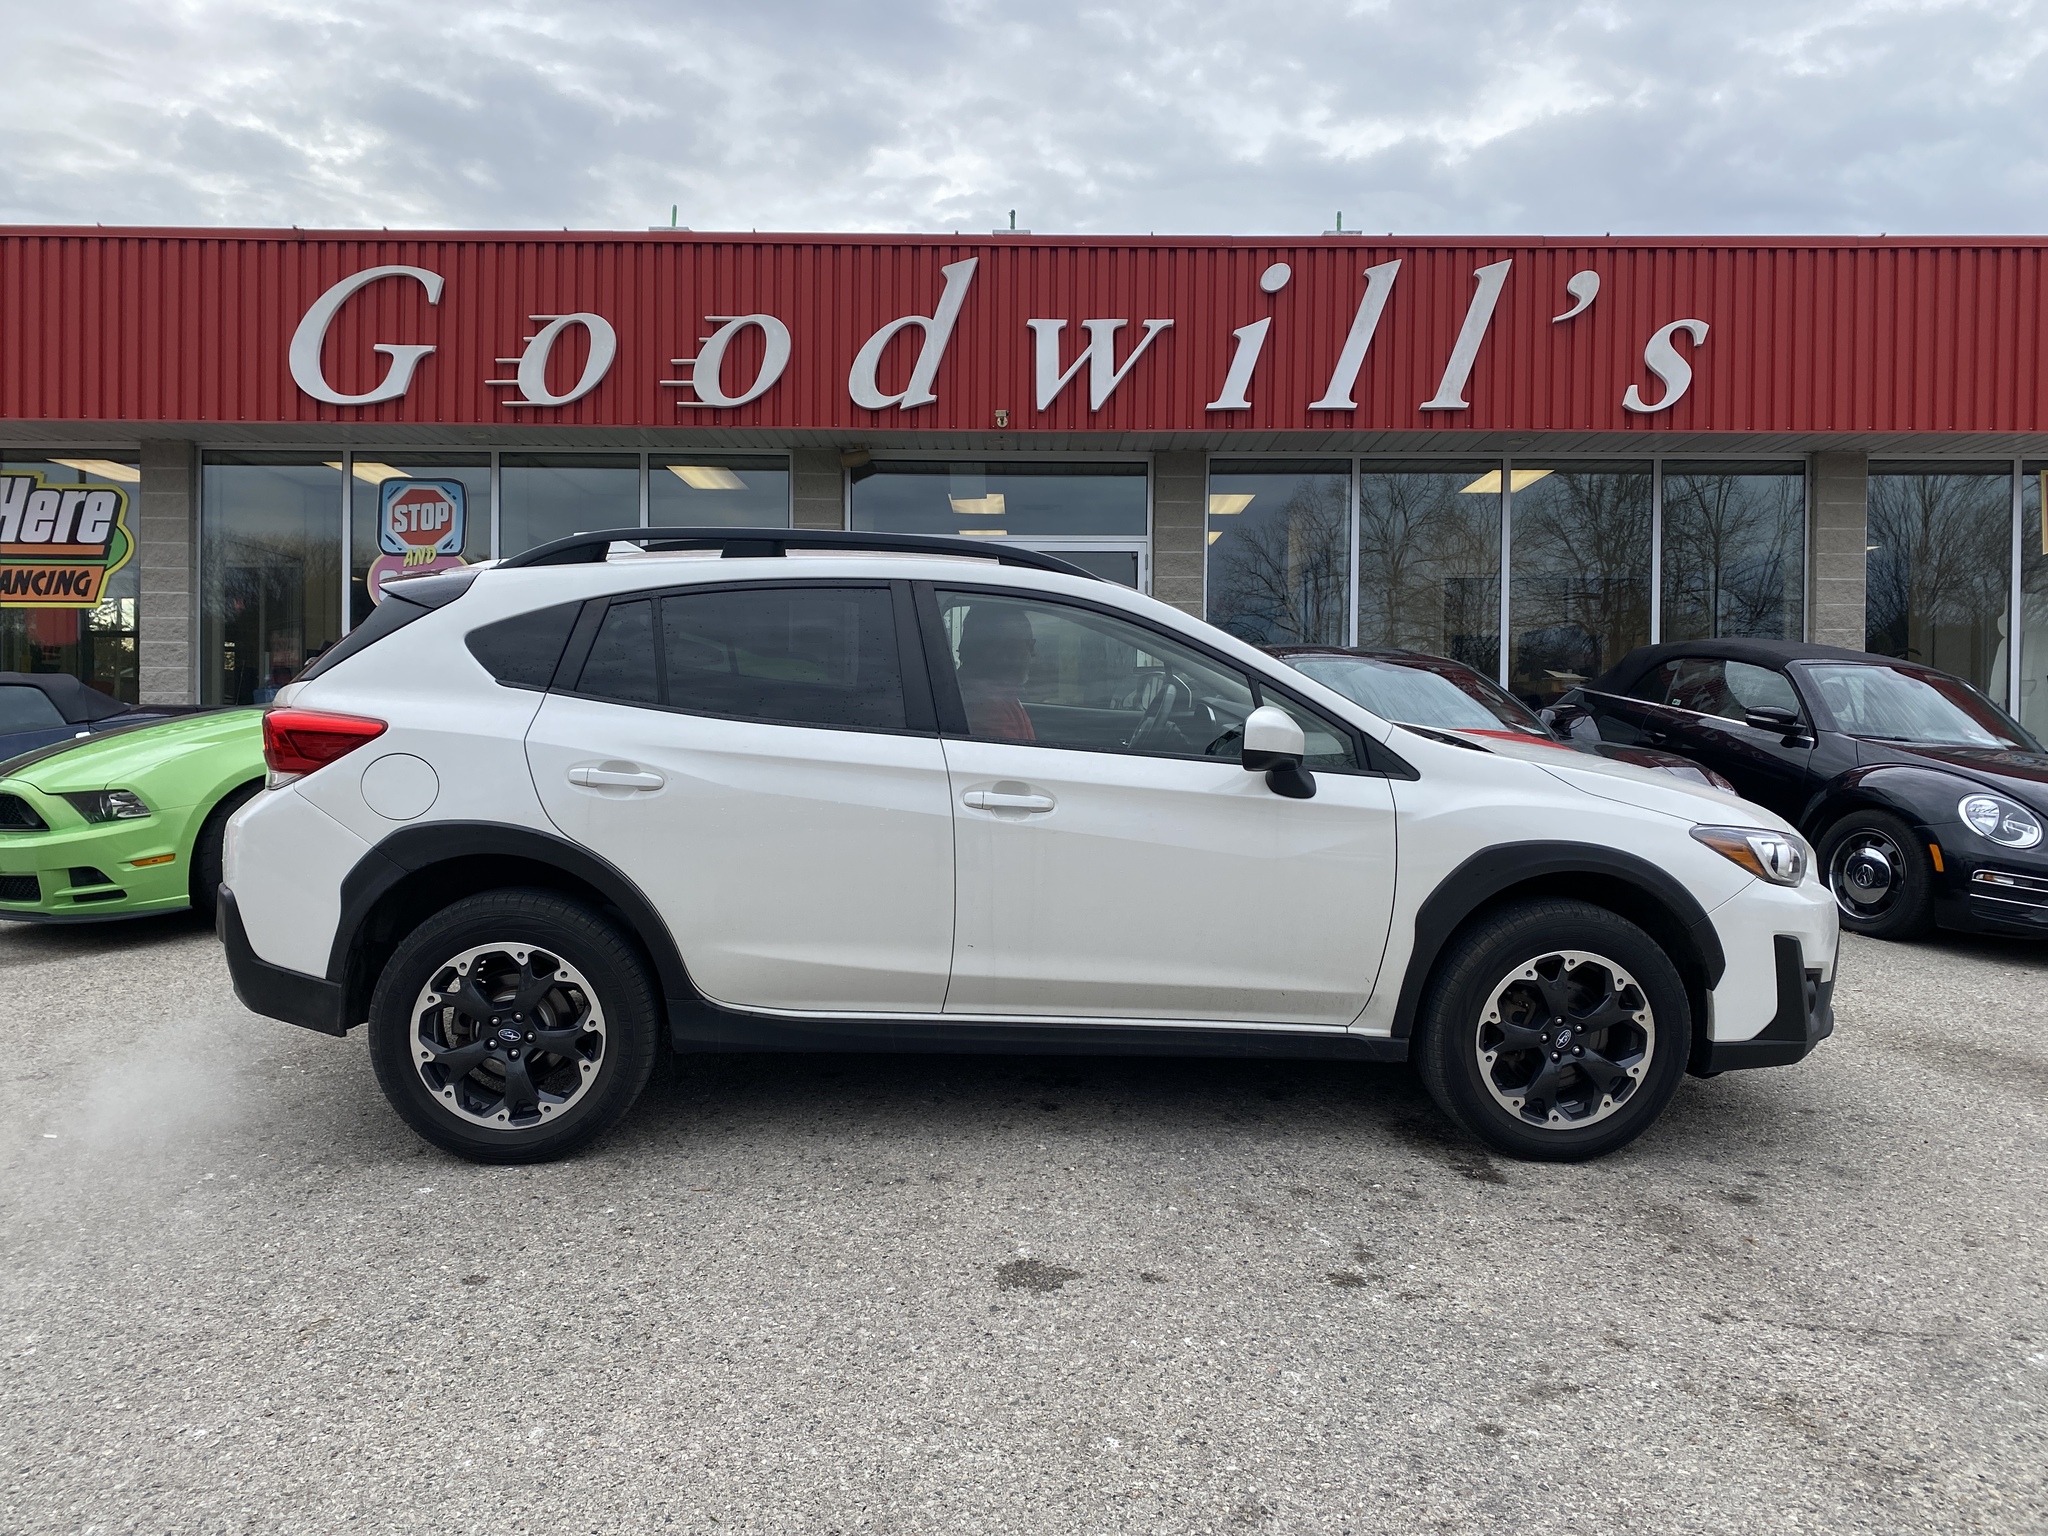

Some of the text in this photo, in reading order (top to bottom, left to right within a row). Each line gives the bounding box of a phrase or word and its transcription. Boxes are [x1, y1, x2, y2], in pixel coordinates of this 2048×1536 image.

[288, 256, 1710, 413] Goodwill's
[0, 477, 117, 543] Here
[394, 502, 450, 533] STOP
[402, 545, 438, 568] AND
[0, 568, 92, 597] ANCING
